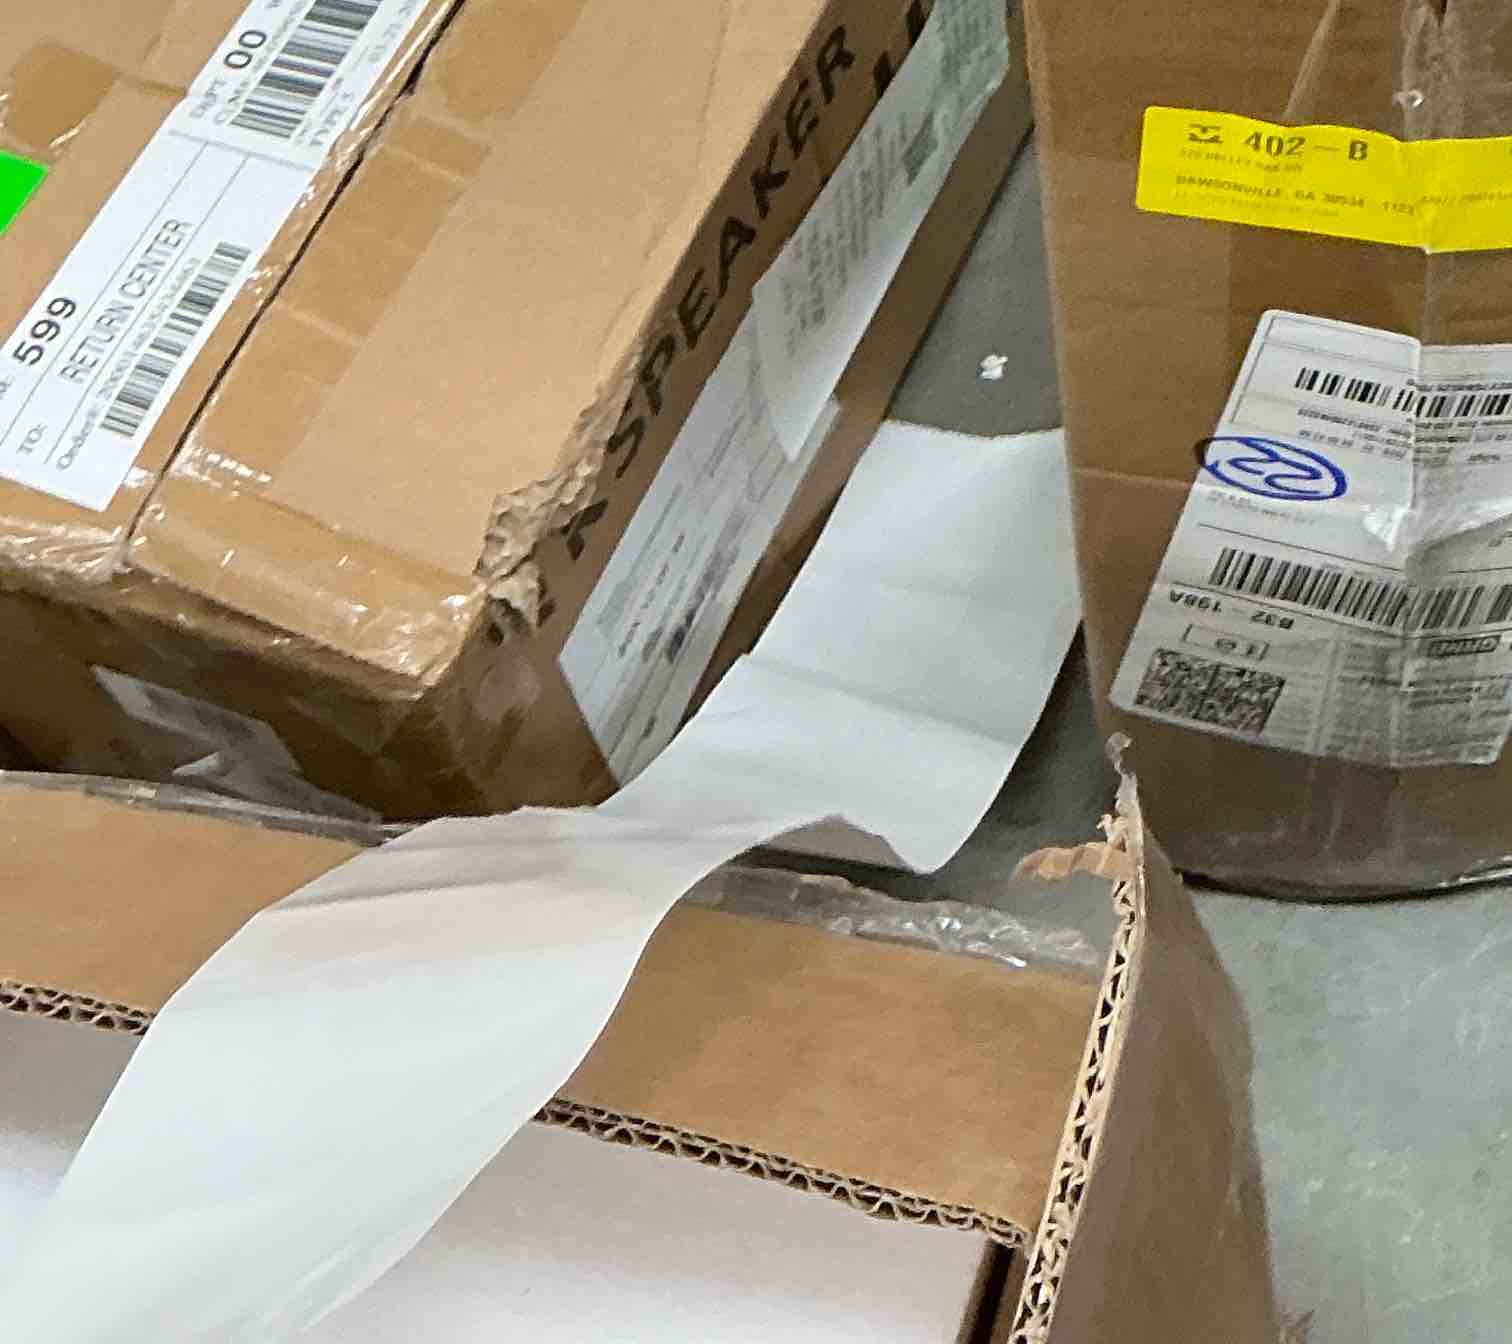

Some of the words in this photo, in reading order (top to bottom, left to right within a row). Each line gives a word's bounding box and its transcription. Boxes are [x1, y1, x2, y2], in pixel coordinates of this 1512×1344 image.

[223, 29, 268, 72] 00
[1243, 130, 1307, 157] 402
[605, 20, 858, 479] SPEAKER
[14, 295, 78, 367] 599
[61, 298, 135, 383] RETURN
[126, 217, 193, 304] CENTER
